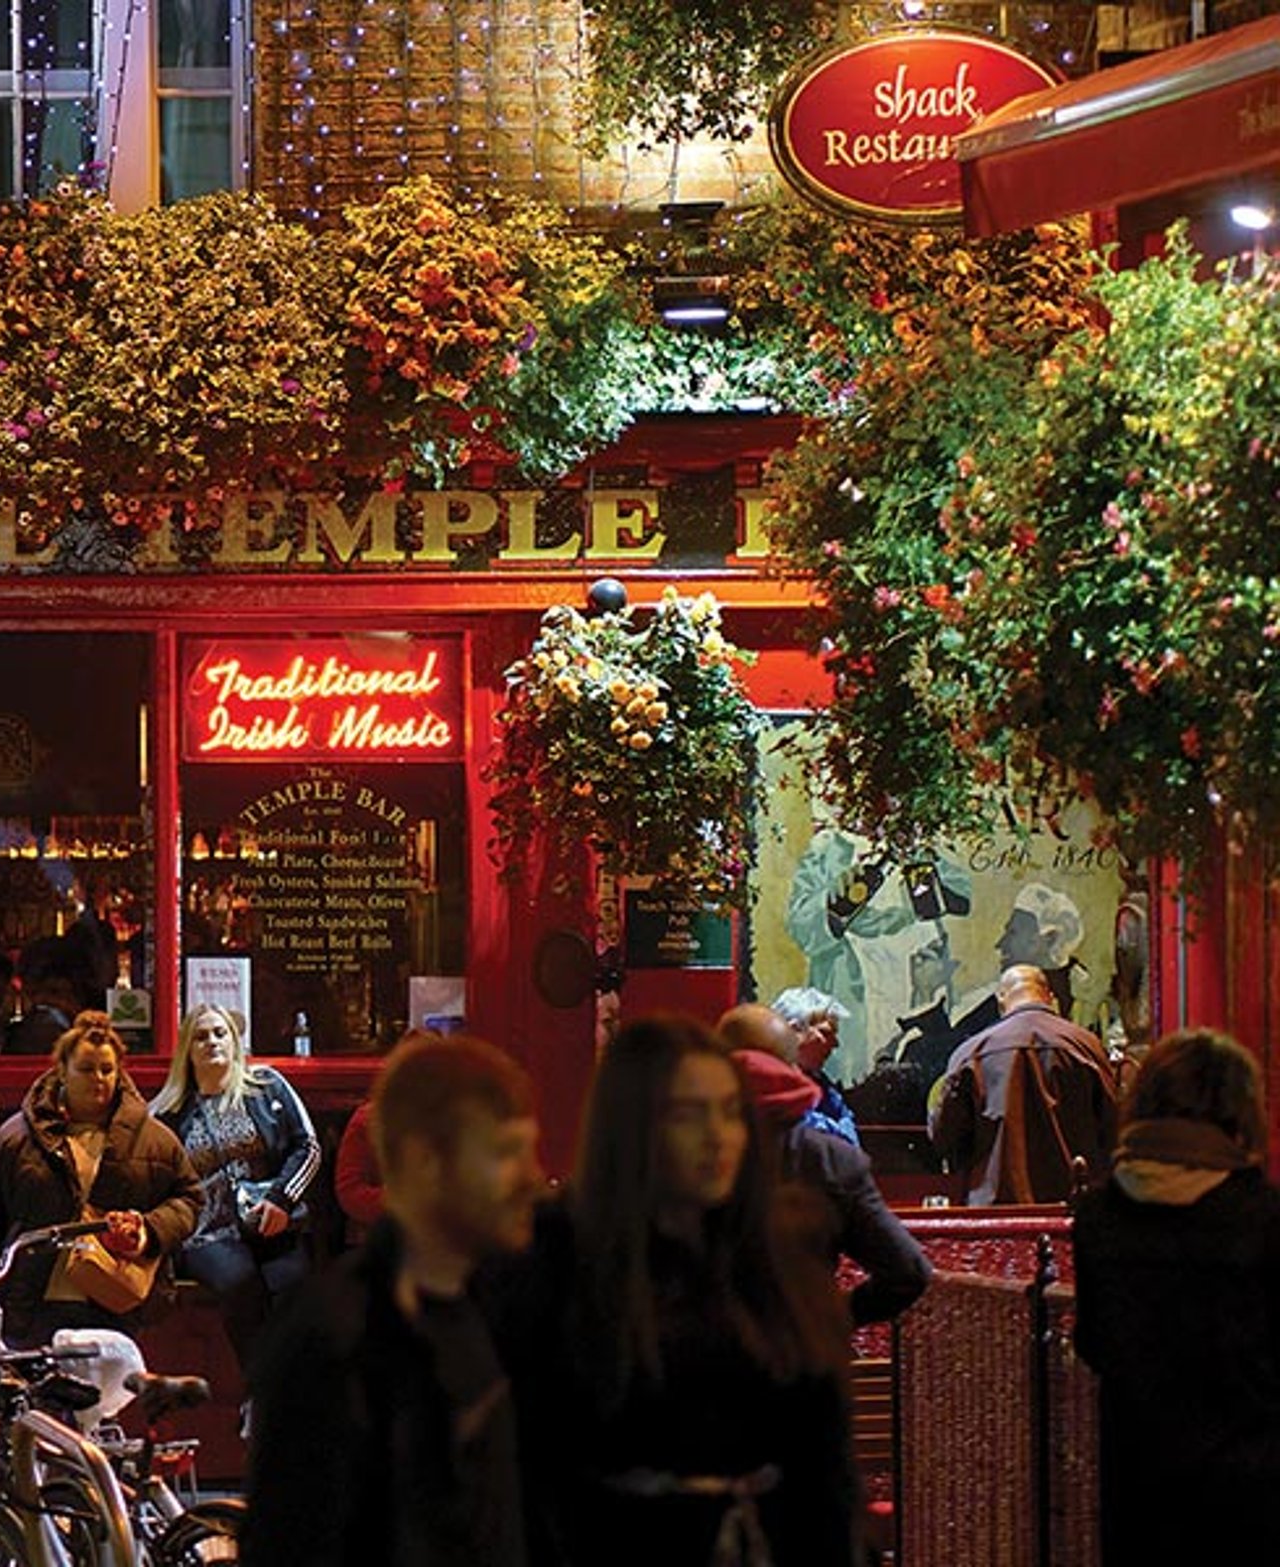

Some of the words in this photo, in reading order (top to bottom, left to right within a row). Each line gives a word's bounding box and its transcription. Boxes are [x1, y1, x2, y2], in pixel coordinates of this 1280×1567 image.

[874, 62, 980, 124] Shack
[823, 128, 959, 168] Restau
[205, 651, 441, 703] Traditional
[200, 704, 310, 751] Irish
[328, 704, 451, 749] Music
[240, 781, 347, 825] TEMPLE
[356, 787, 407, 827] BAR
